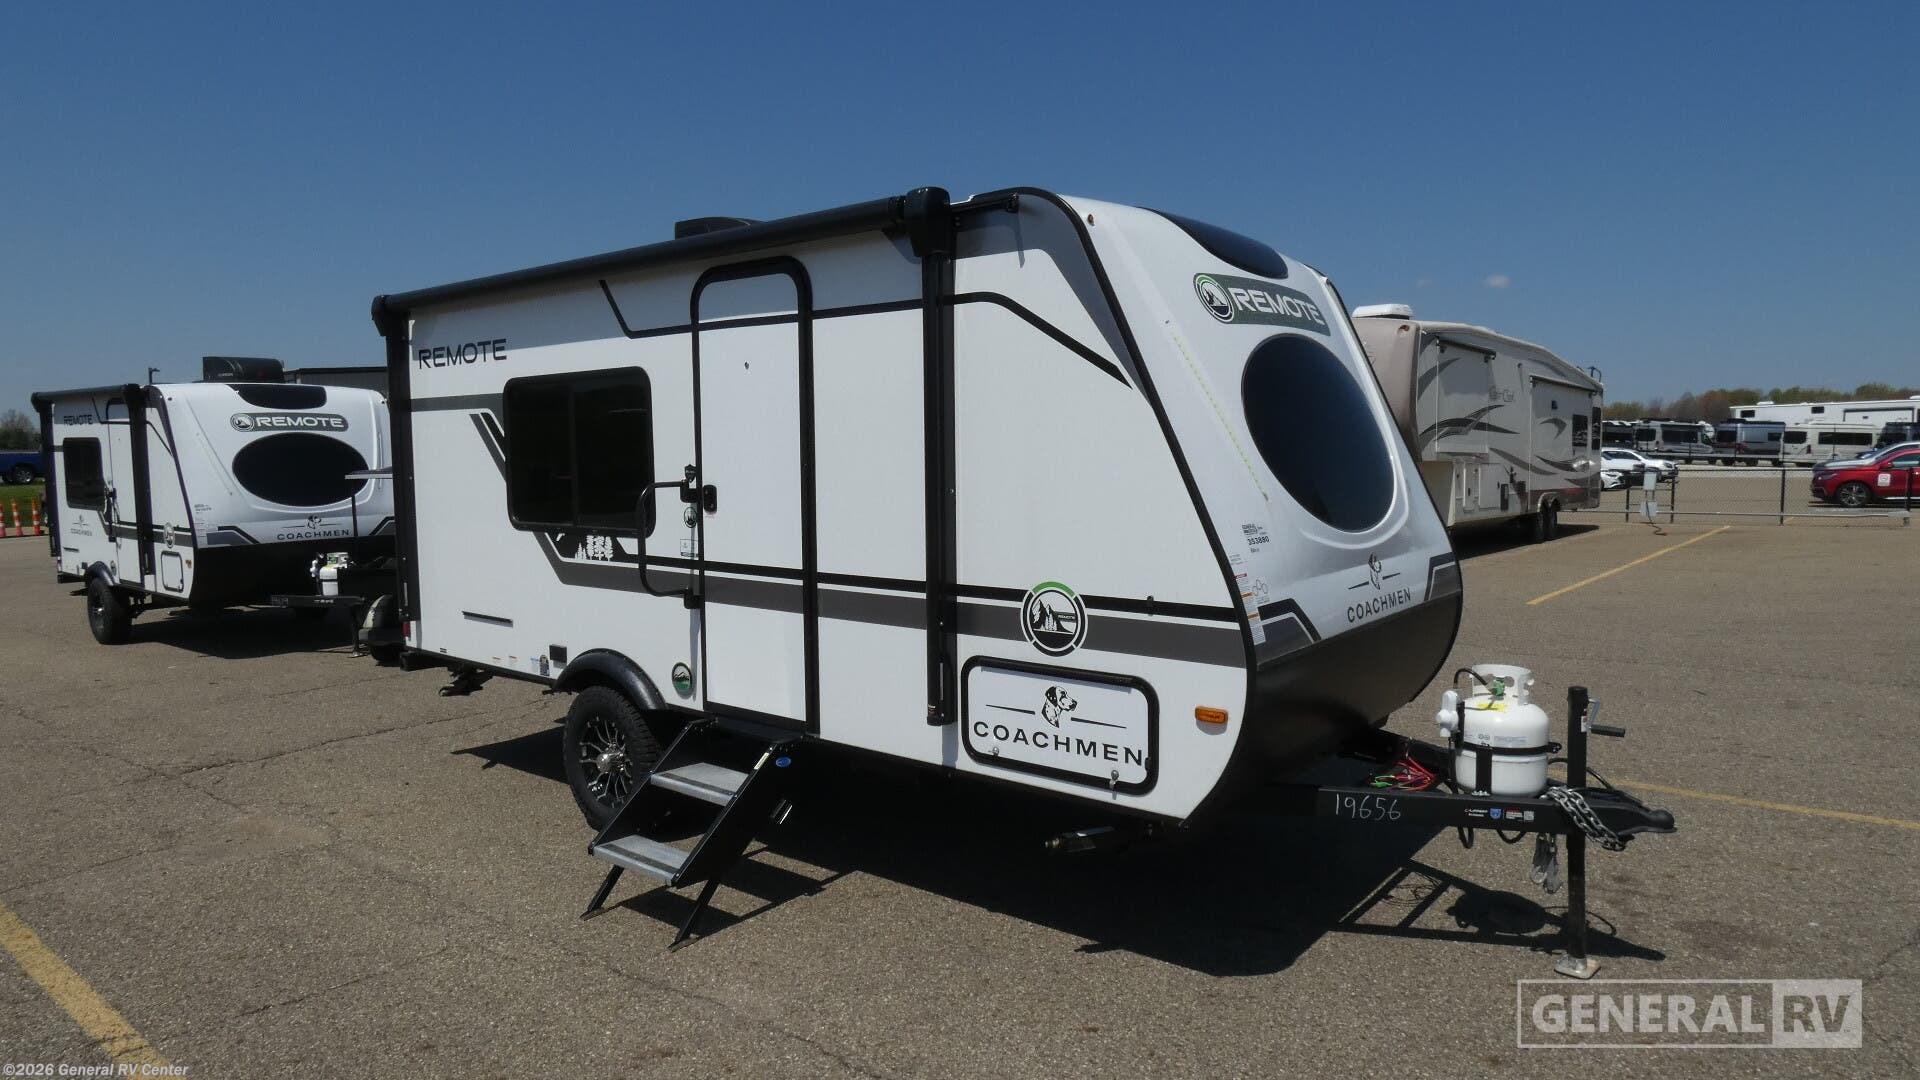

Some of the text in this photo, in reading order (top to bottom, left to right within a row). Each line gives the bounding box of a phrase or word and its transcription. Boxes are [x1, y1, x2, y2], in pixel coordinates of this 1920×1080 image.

[1228, 288, 1325, 325] REMOTE
[419, 338, 507, 369] REMOTE
[256, 416, 344, 427] REMOTE
[277, 530, 349, 540] COACHMEN
[1346, 588, 1412, 623] COACHMEN
[973, 721, 1143, 766] COACHMEN
[1335, 793, 1402, 821] 19656
